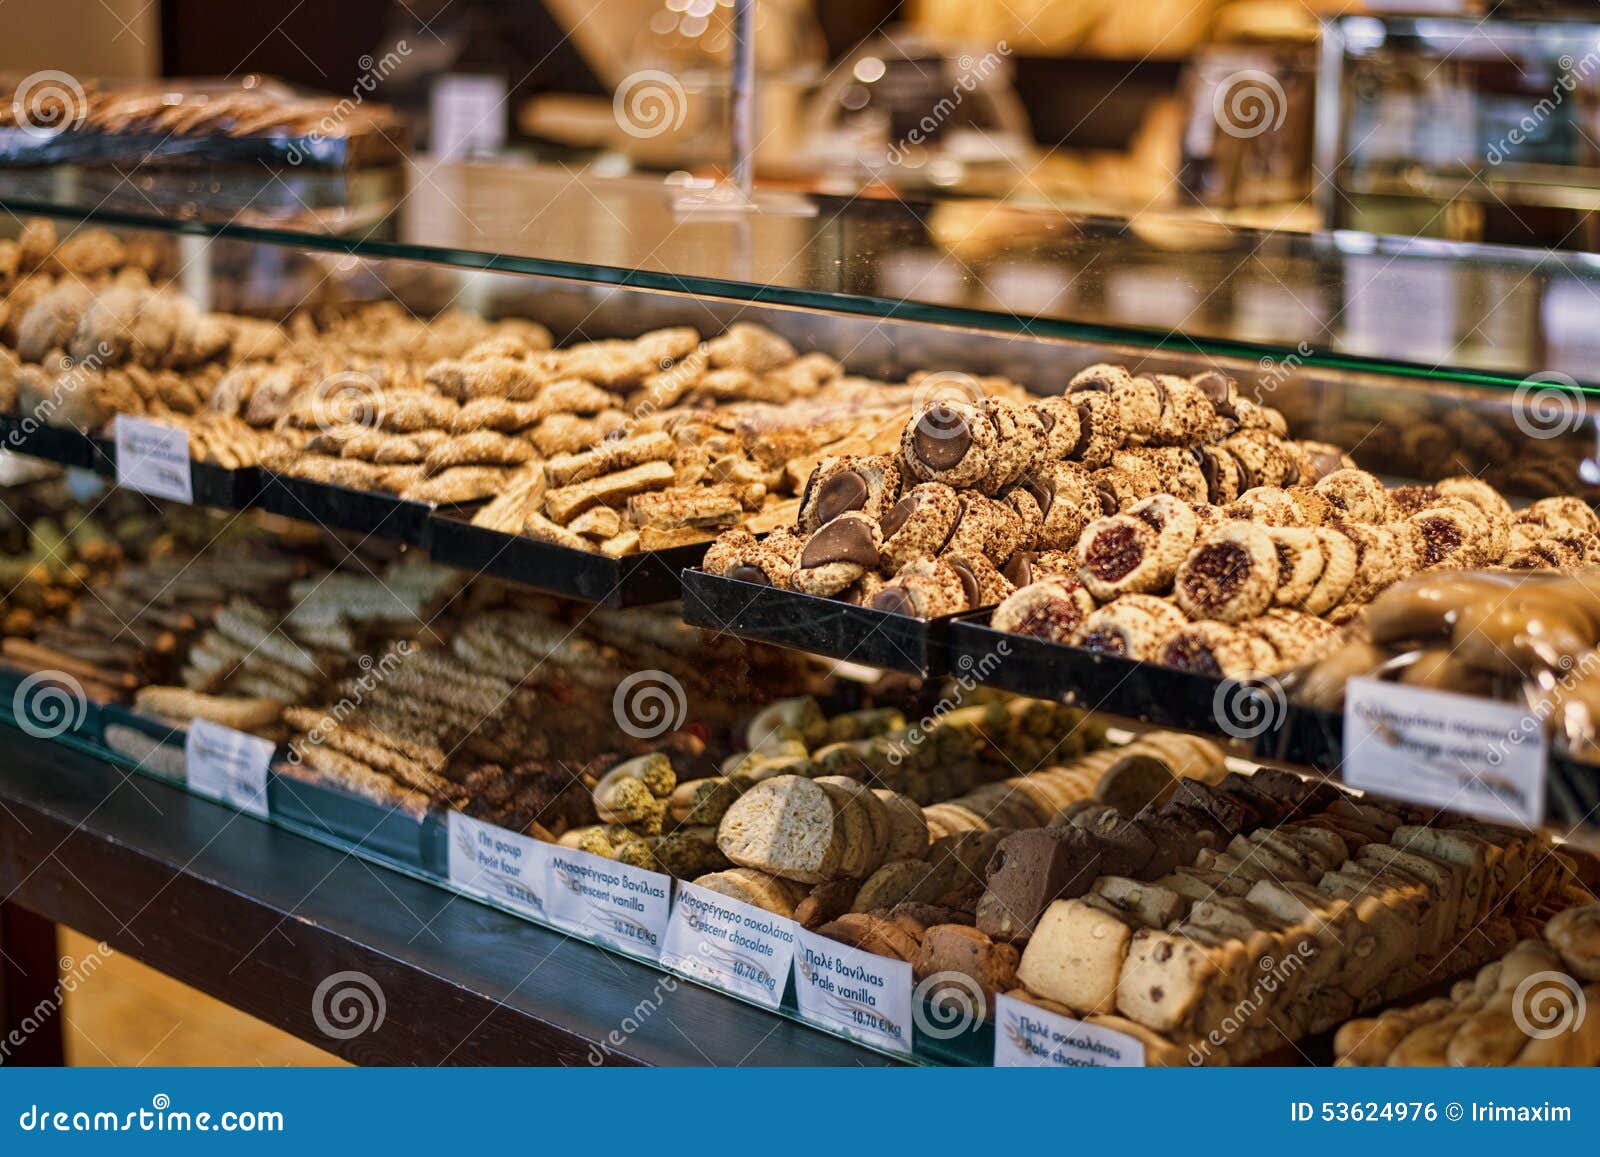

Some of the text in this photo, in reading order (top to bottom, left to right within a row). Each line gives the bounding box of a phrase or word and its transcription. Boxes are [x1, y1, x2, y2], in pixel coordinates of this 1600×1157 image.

[478, 850, 520, 877] Petit four
[571, 879, 645, 912] Crescent vanilla
[622, 875, 665, 899] βανίλιας
[688, 914, 774, 957] Crescent chocolate
[743, 919, 794, 944] σοκολάτας
[733, 961, 777, 991] 10.70 €/kg
[805, 948, 884, 987] Παλέ βανίλιας
[811, 972, 876, 1006] Pale vanilla
[852, 1009, 901, 1038] 10.70 €/kg
[1019, 1016, 1049, 1039] Παλέ
[1024, 1038, 1050, 1058] Pale
